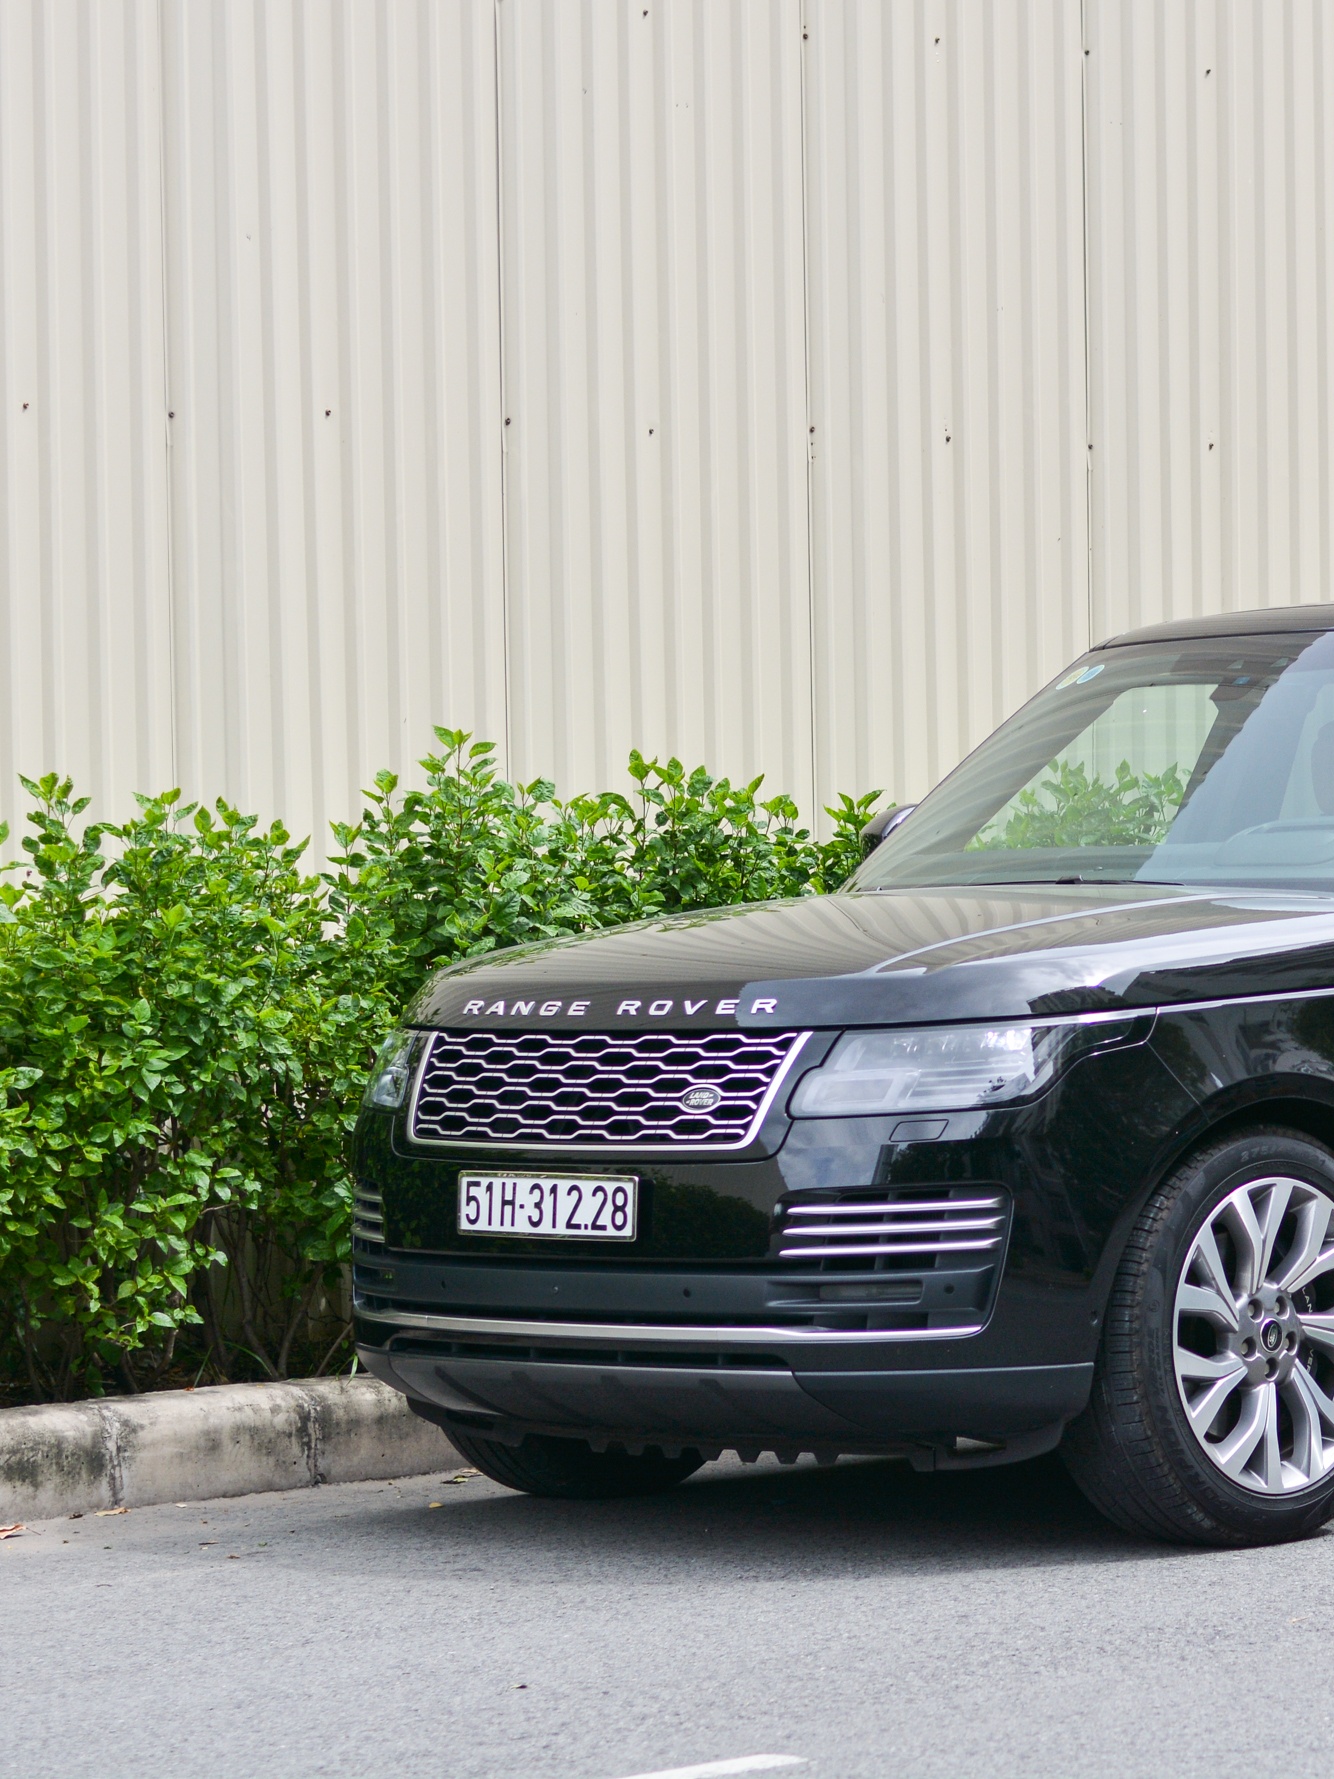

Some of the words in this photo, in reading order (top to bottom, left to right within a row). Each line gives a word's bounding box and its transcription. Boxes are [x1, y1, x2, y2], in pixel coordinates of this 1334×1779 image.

[462, 1000, 591, 1017] RANGE
[616, 998, 778, 1016] ROVER
[465, 1180, 629, 1232] 51H-312.28
